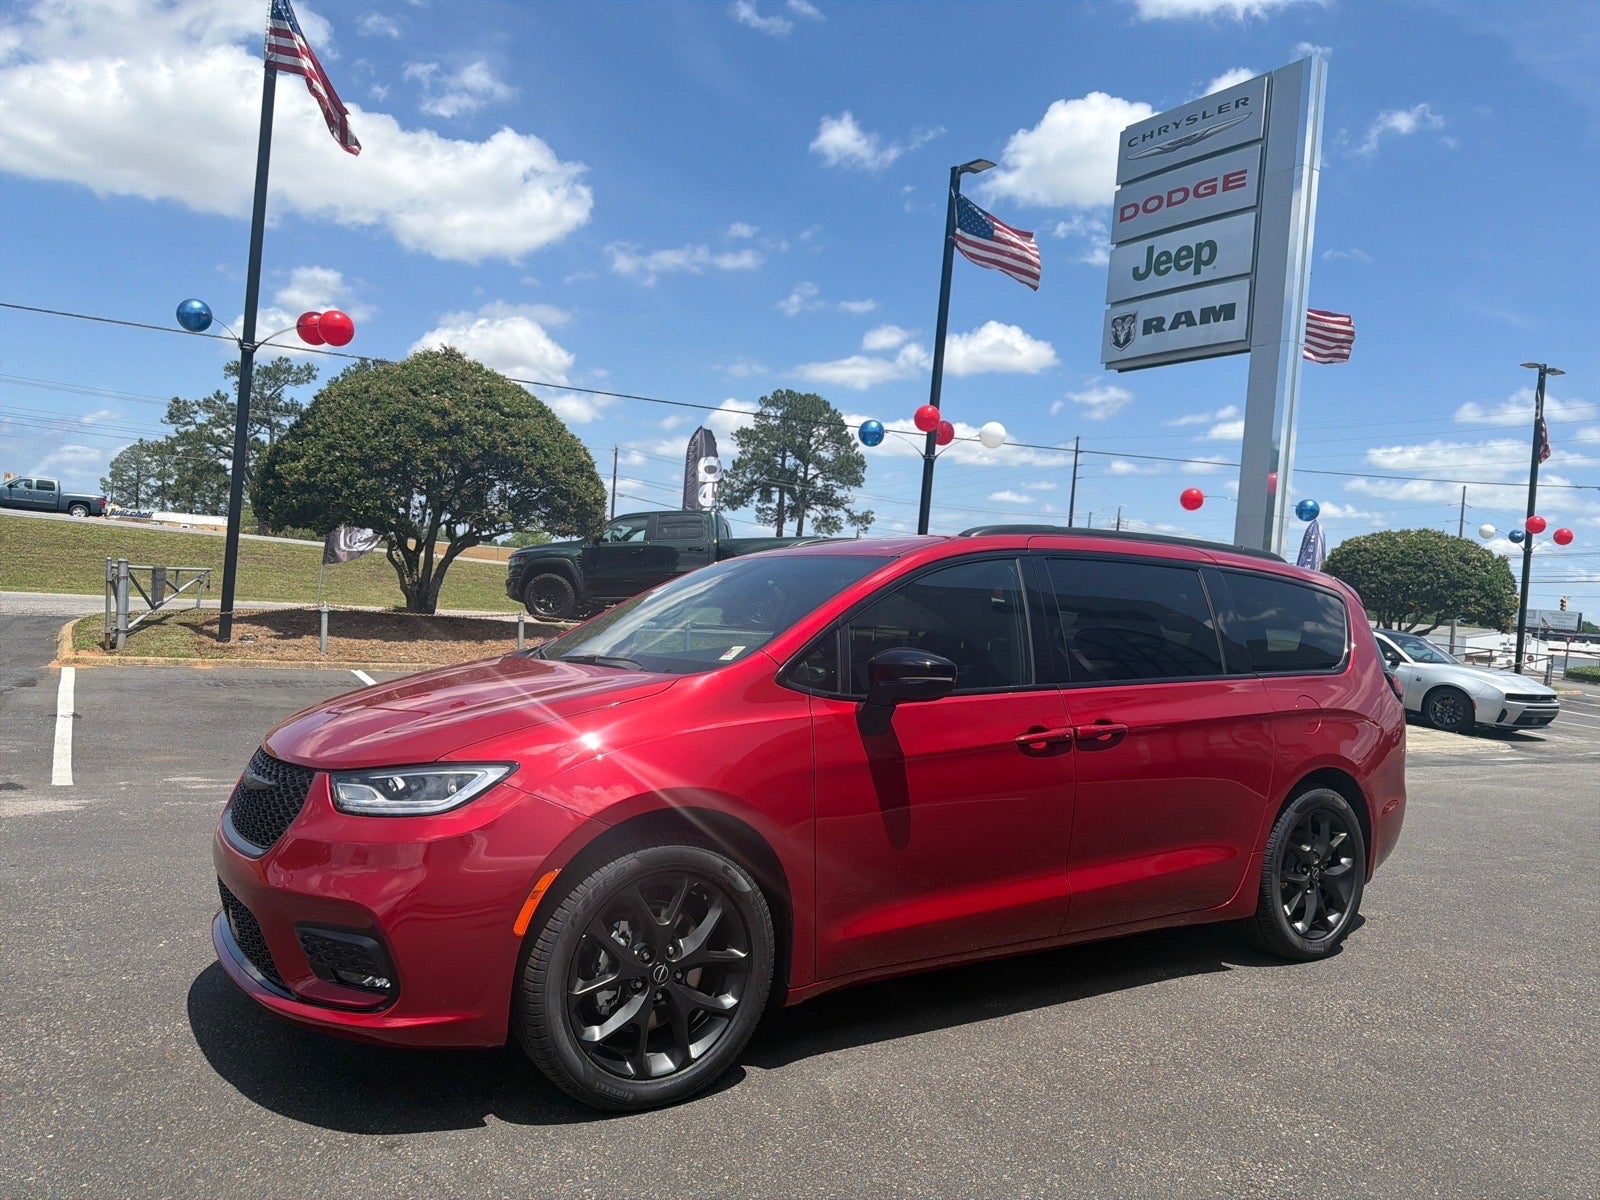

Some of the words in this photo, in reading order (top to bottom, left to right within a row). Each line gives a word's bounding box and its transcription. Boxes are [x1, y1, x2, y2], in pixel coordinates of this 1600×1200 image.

[1127, 96, 1250, 148] CHRYSLER
[1119, 169, 1248, 223] DODGE
[1132, 238, 1218, 281] Jeep
[1142, 302, 1236, 336] RAM
